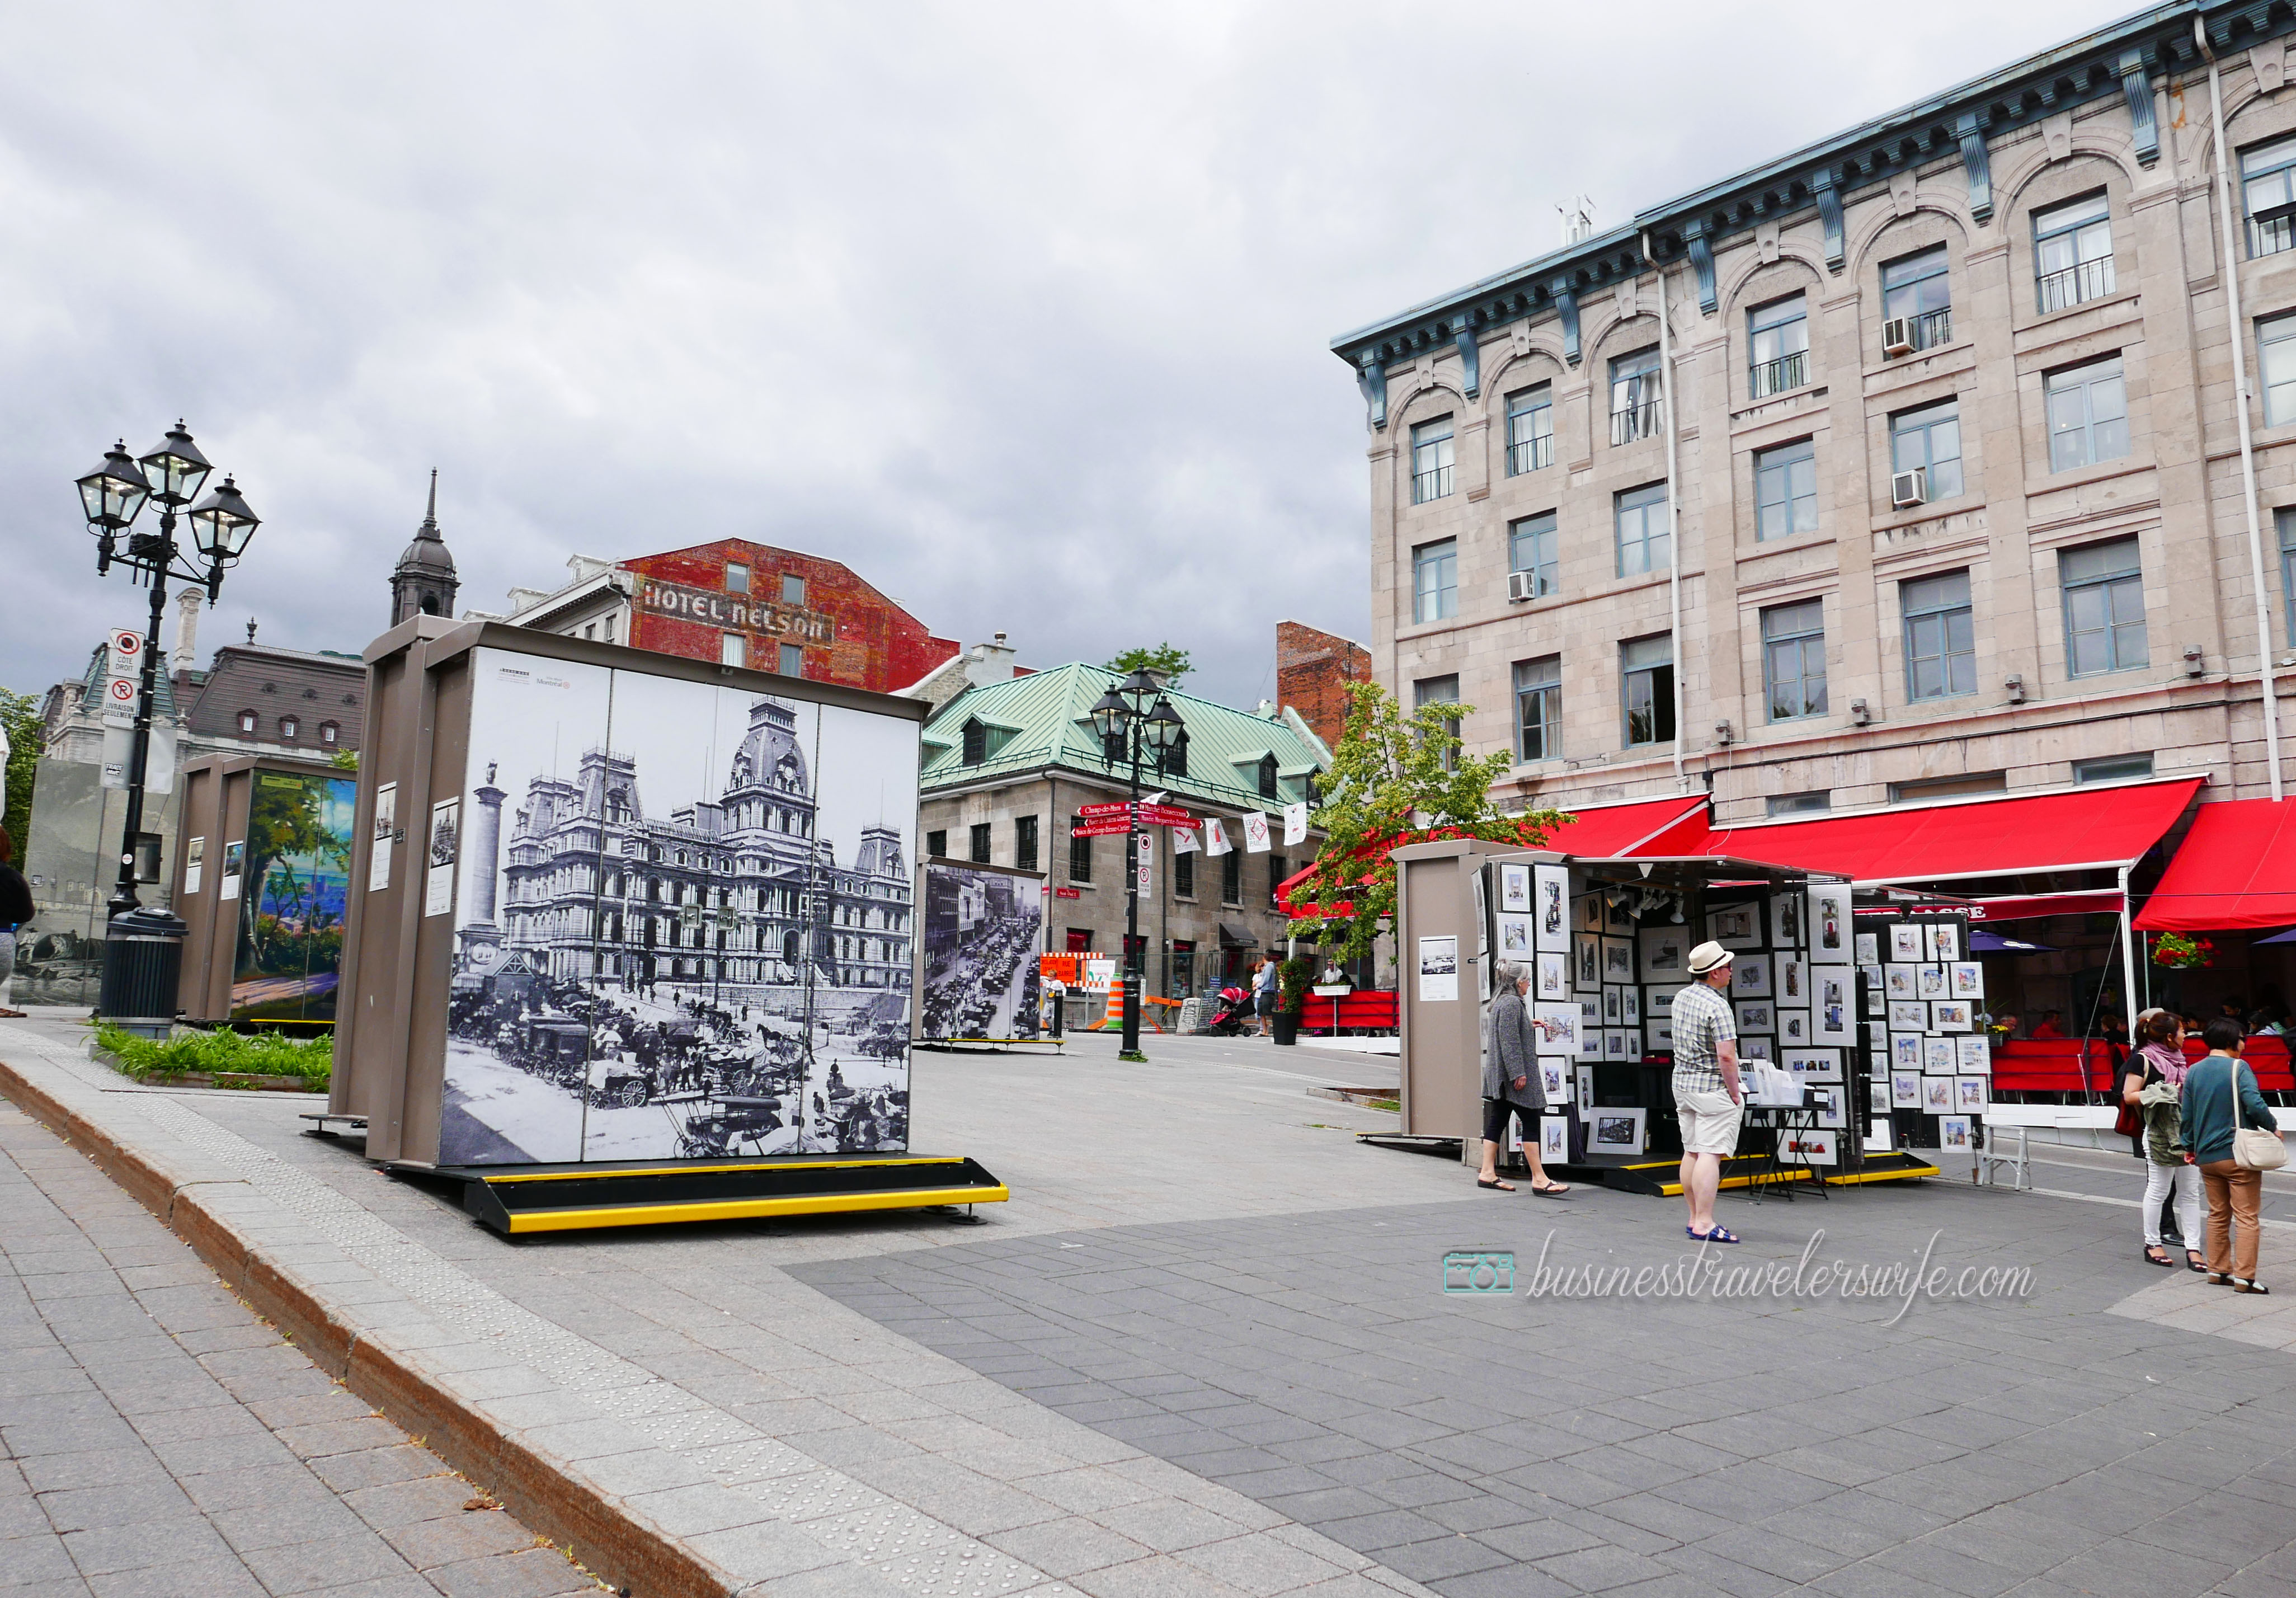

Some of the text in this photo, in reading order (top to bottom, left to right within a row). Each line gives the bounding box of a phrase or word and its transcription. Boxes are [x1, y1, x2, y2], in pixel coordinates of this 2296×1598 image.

[644, 585, 723, 621] HOTEL
[537, 678, 562, 687] Montréal
[106, 702, 134, 712] LIVRAISON
[103, 709, 135, 719] SEULEMENT
[1085, 805, 1121, 814] Champ-de-Mars
[1145, 804, 1186, 817] Marché Bonsecours
